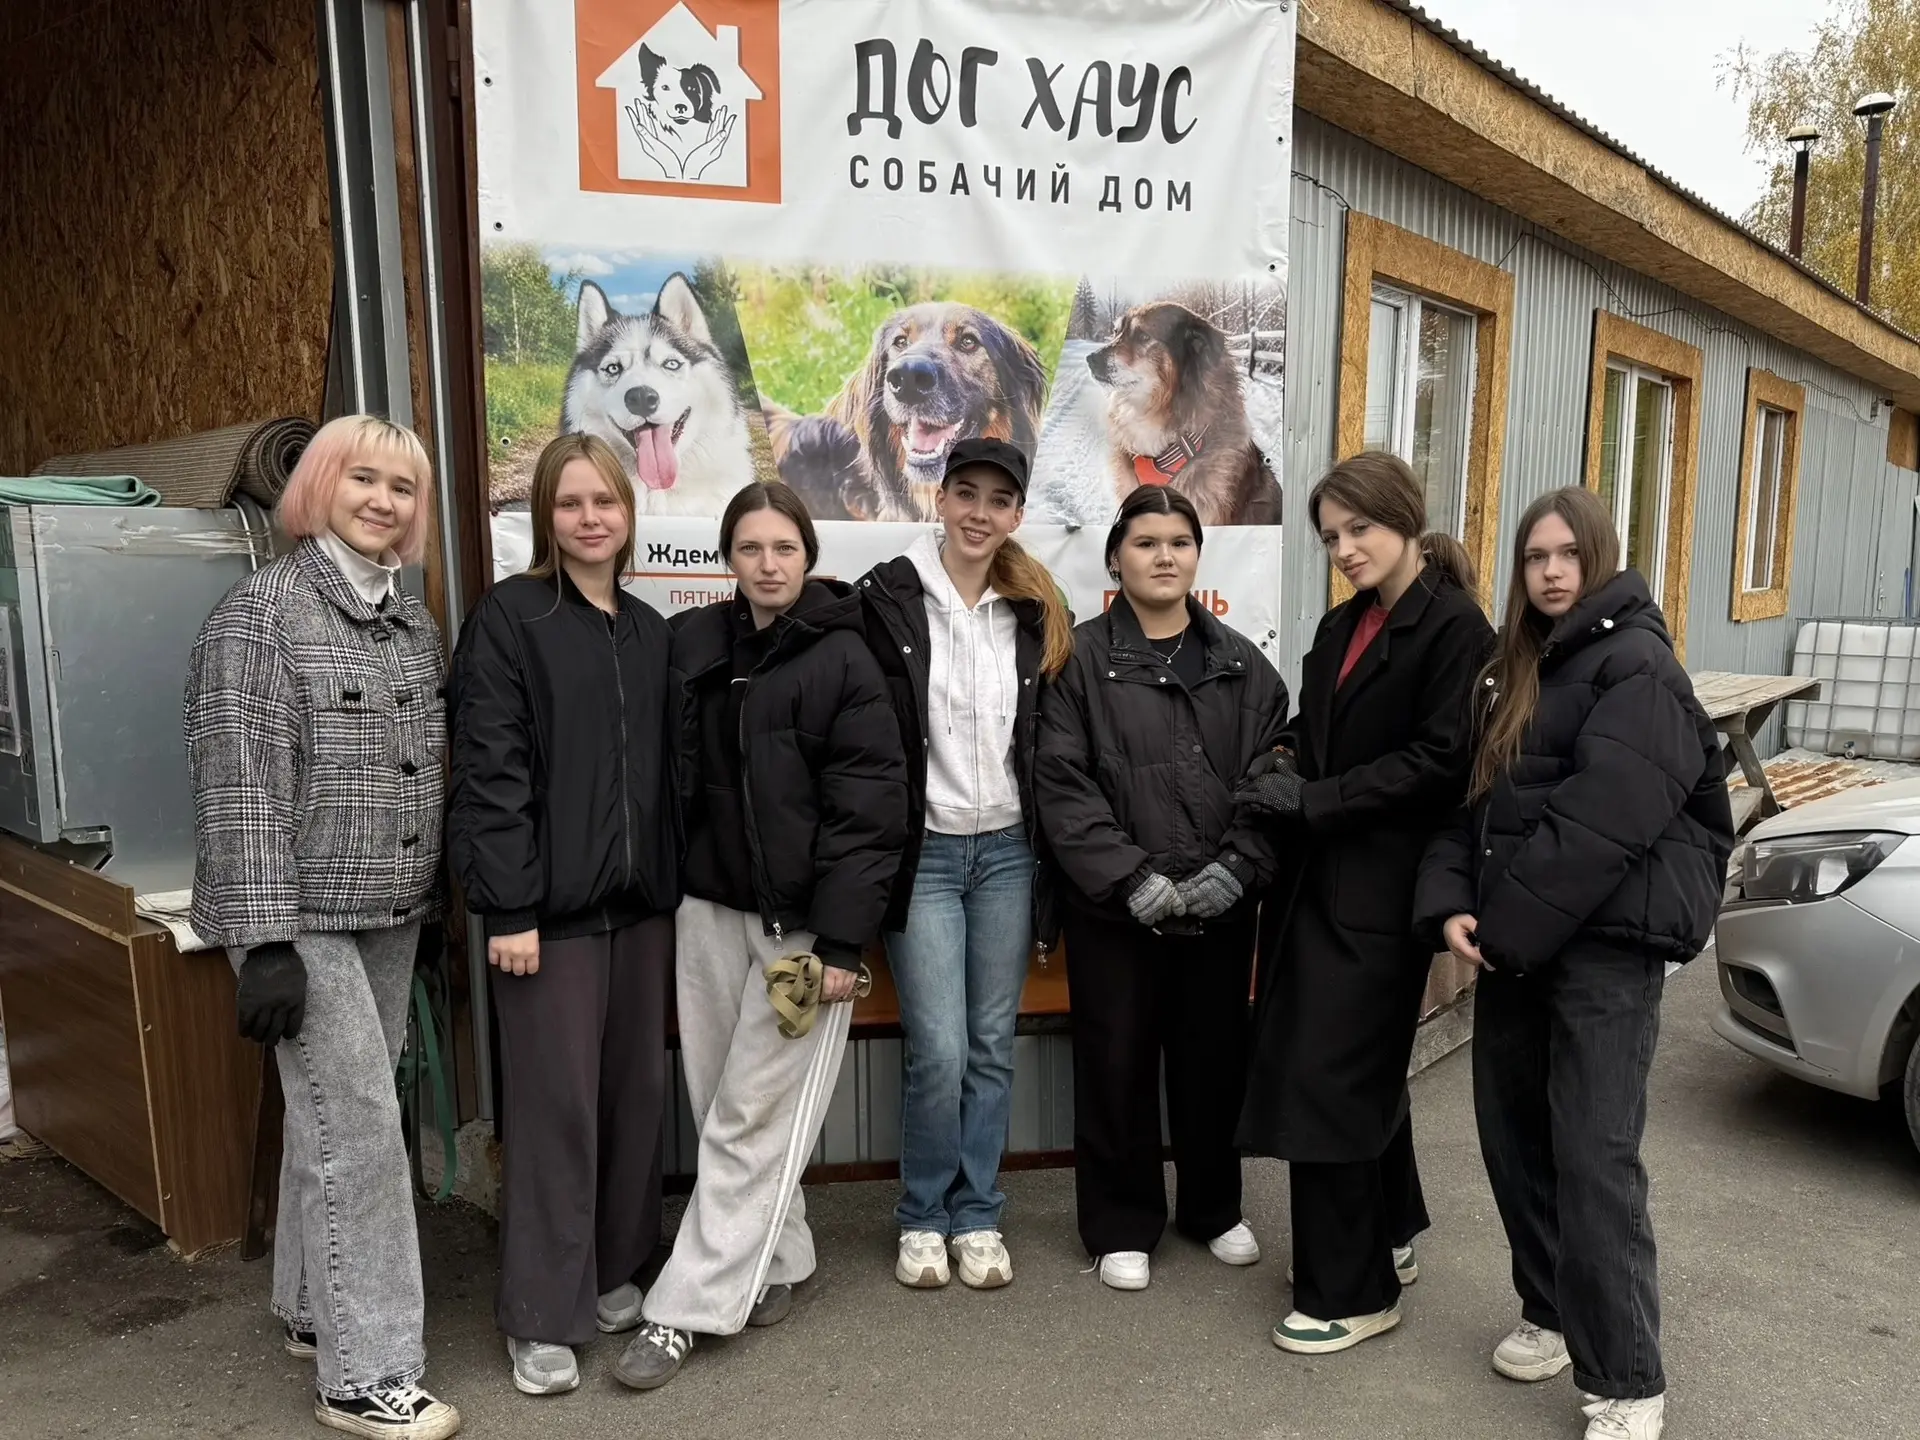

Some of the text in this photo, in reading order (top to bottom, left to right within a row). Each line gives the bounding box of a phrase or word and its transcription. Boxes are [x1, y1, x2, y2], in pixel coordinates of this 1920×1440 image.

[847, 38, 1198, 144] ДОГ ХАУС
[849, 154, 1192, 213] СОБАЧИЙ ДОМ
[647, 543, 719, 567] Ждем
[670, 590, 733, 605] ПЯТНИ
